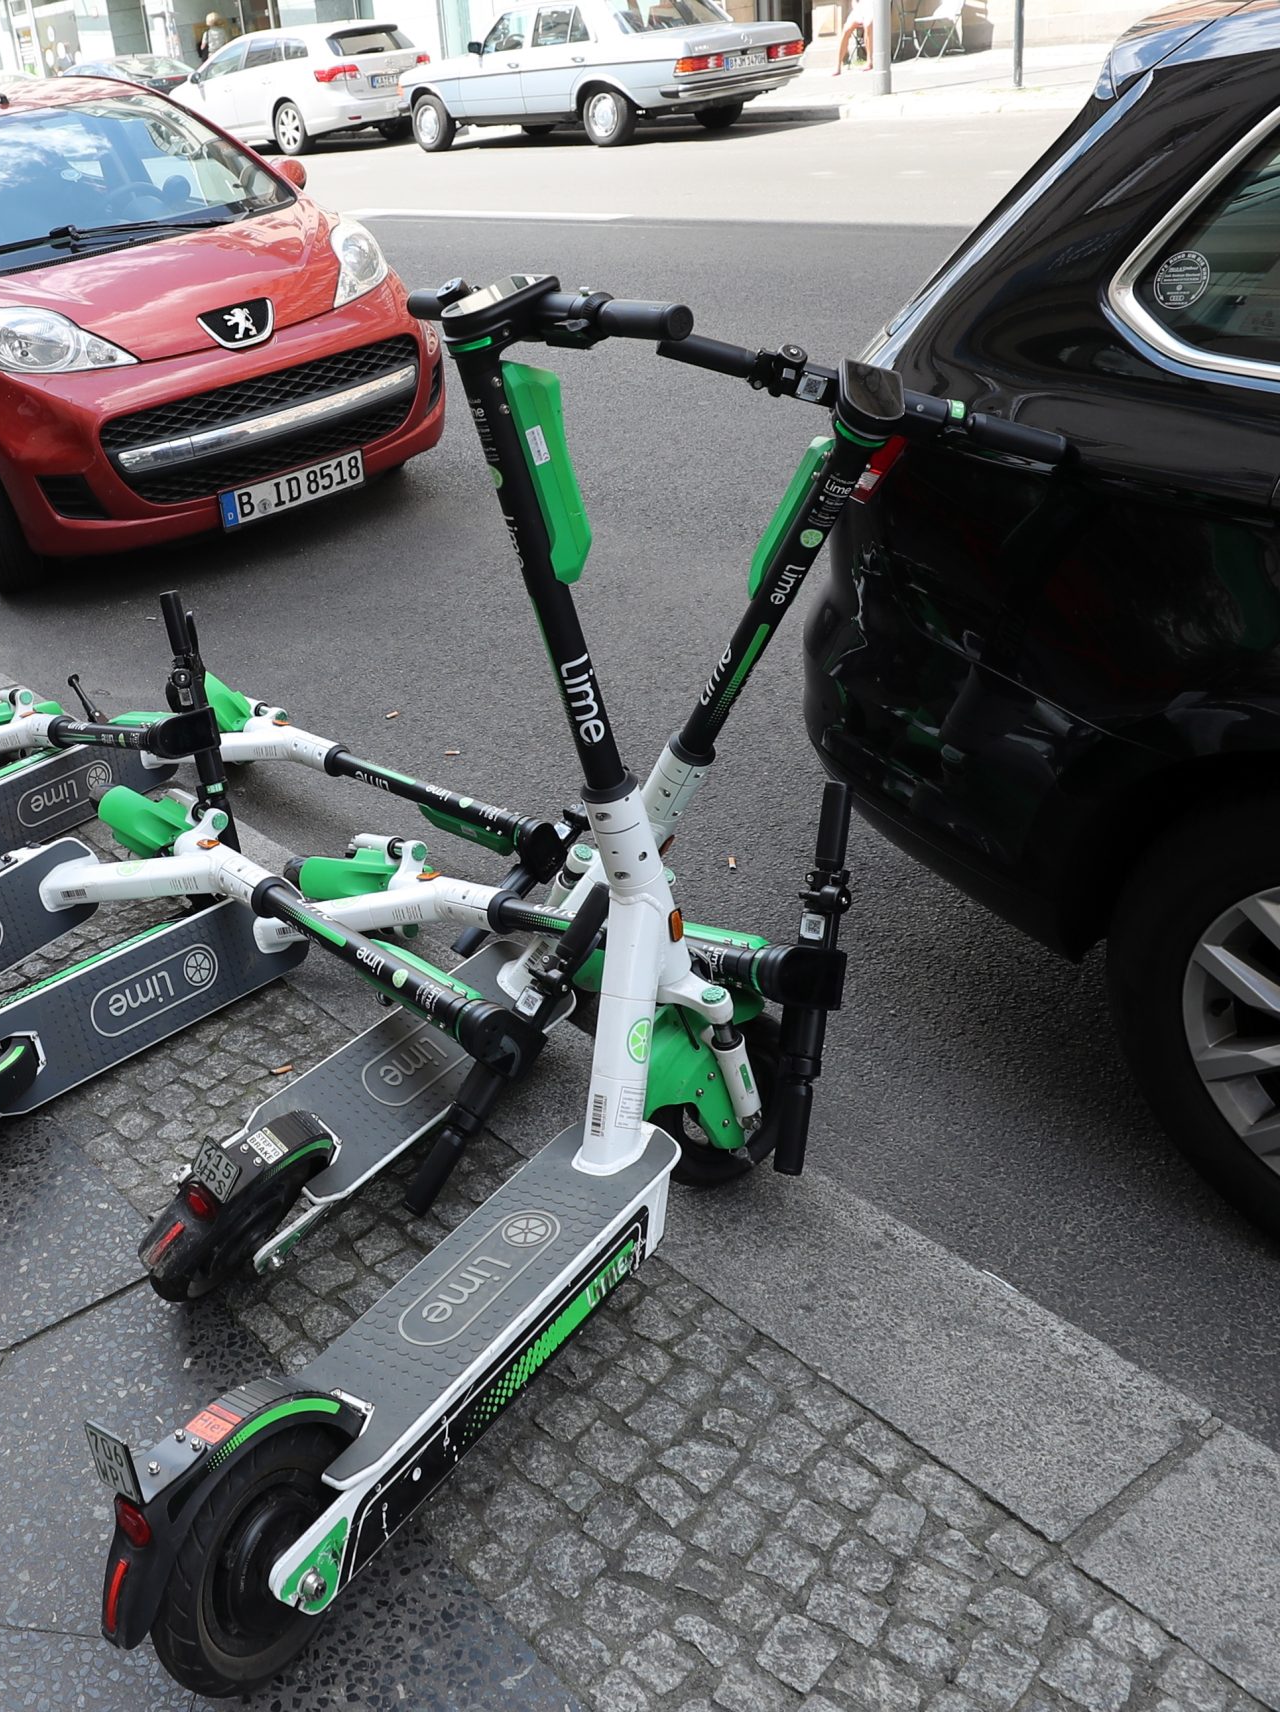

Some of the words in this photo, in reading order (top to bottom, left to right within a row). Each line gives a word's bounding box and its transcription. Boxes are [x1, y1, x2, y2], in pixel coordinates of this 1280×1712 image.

[237, 491, 257, 519] B
[273, 474, 302, 509] ID
[306, 455, 362, 495] 8518
[824, 479, 853, 496] Lime
[770, 564, 807, 606] Lime
[560, 652, 606, 744] Lime
[30, 778, 80, 813] Lime
[356, 946, 386, 976] Lime
[108, 970, 175, 1017] Lime
[379, 1036, 449, 1087] Lime
[204, 1146, 235, 1179] 415
[249, 1137, 275, 1162] BRAKE
[255, 1132, 273, 1149] STEP
[270, 1147, 281, 1158] TO
[421, 1255, 513, 1324] Lime
[197, 1413, 228, 1436] Hier
[88, 1430, 124, 1468] 706
[96, 1456, 134, 1498] WPL
